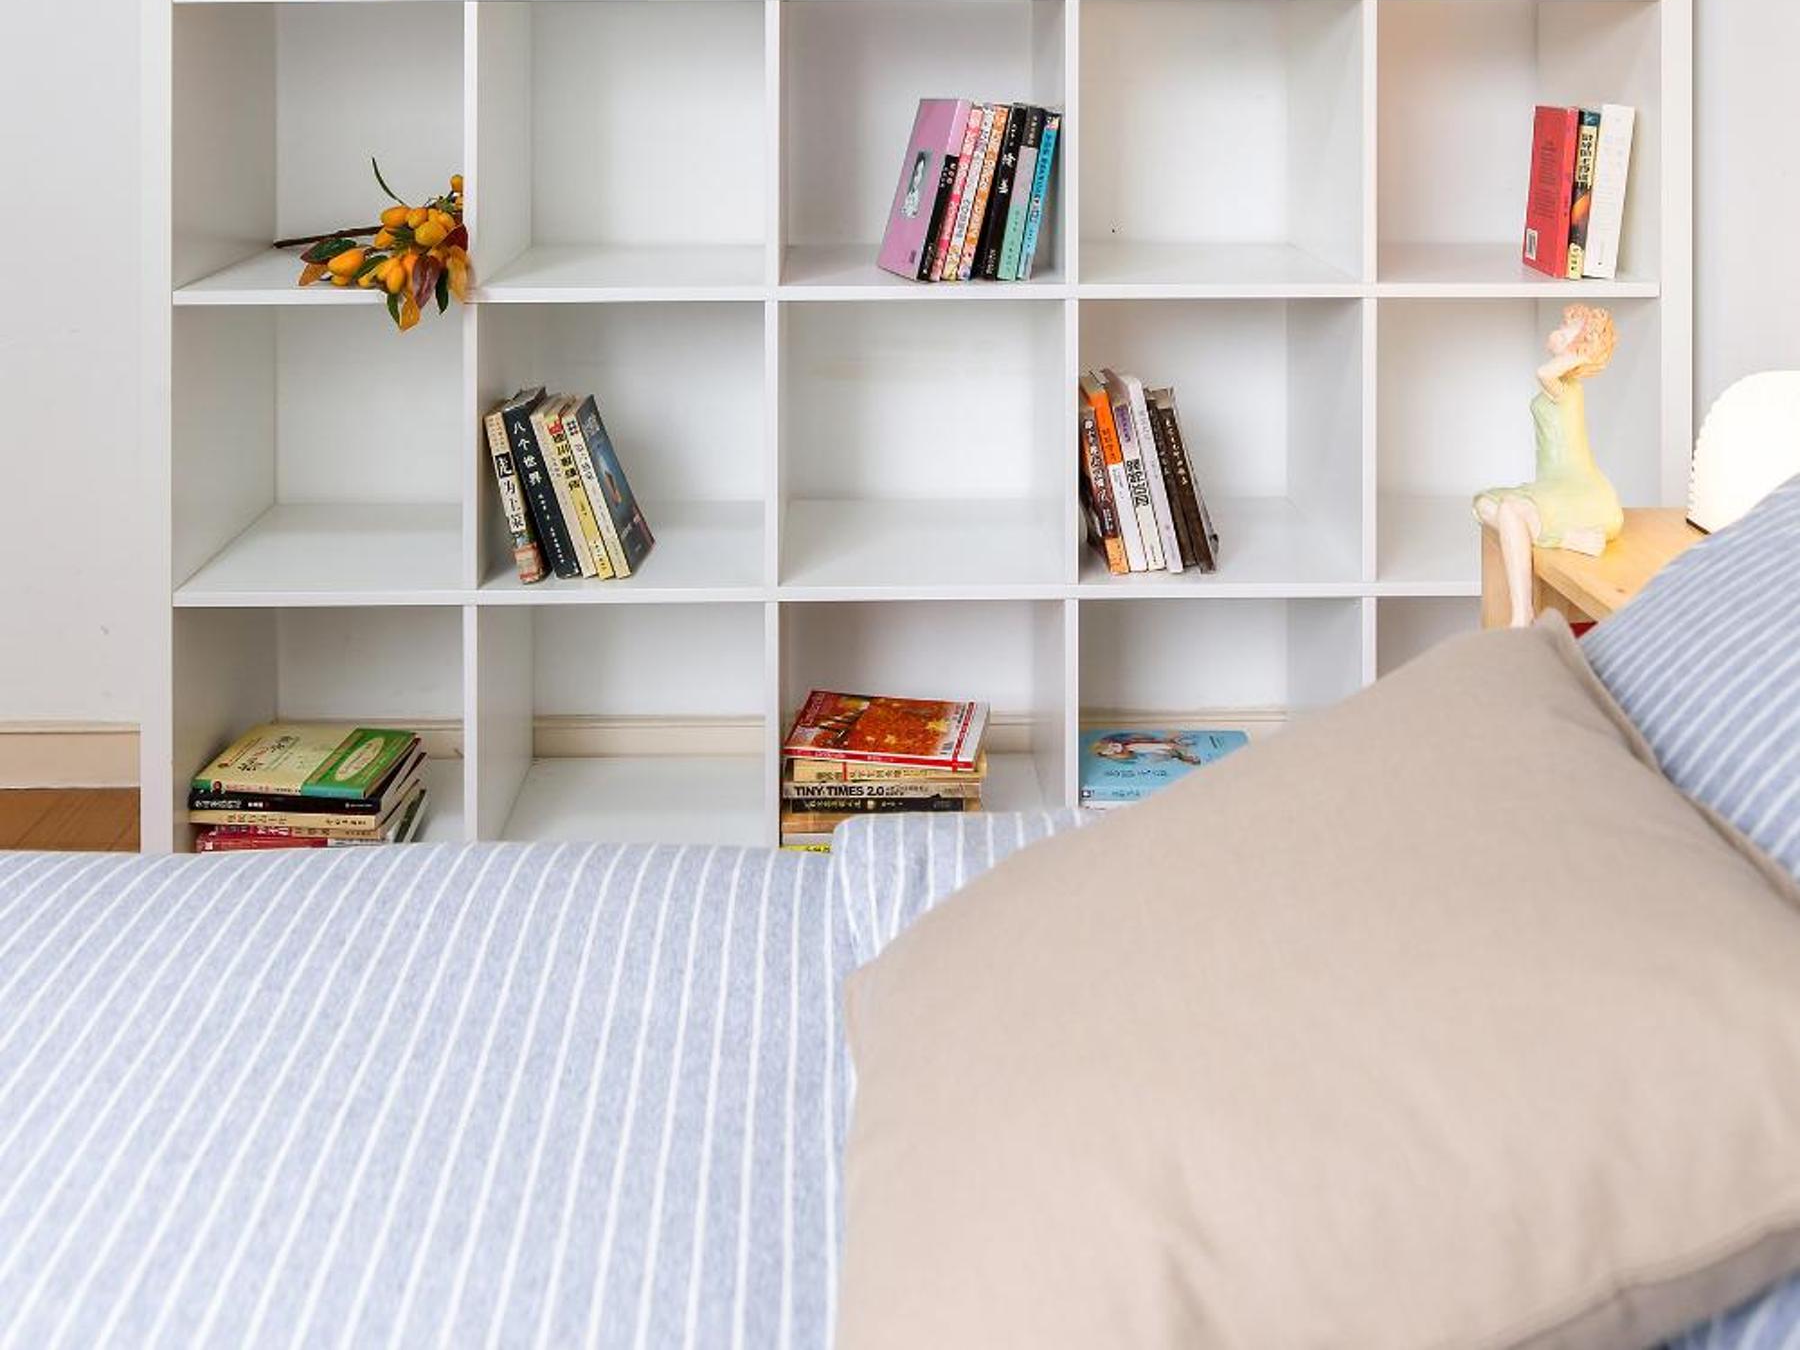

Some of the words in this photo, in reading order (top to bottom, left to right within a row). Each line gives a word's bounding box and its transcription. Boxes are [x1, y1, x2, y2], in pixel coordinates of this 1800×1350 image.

[794, 786, 824, 796] TINY
[826, 786, 864, 796] TIMES
[867, 786, 884, 796] 2.0
